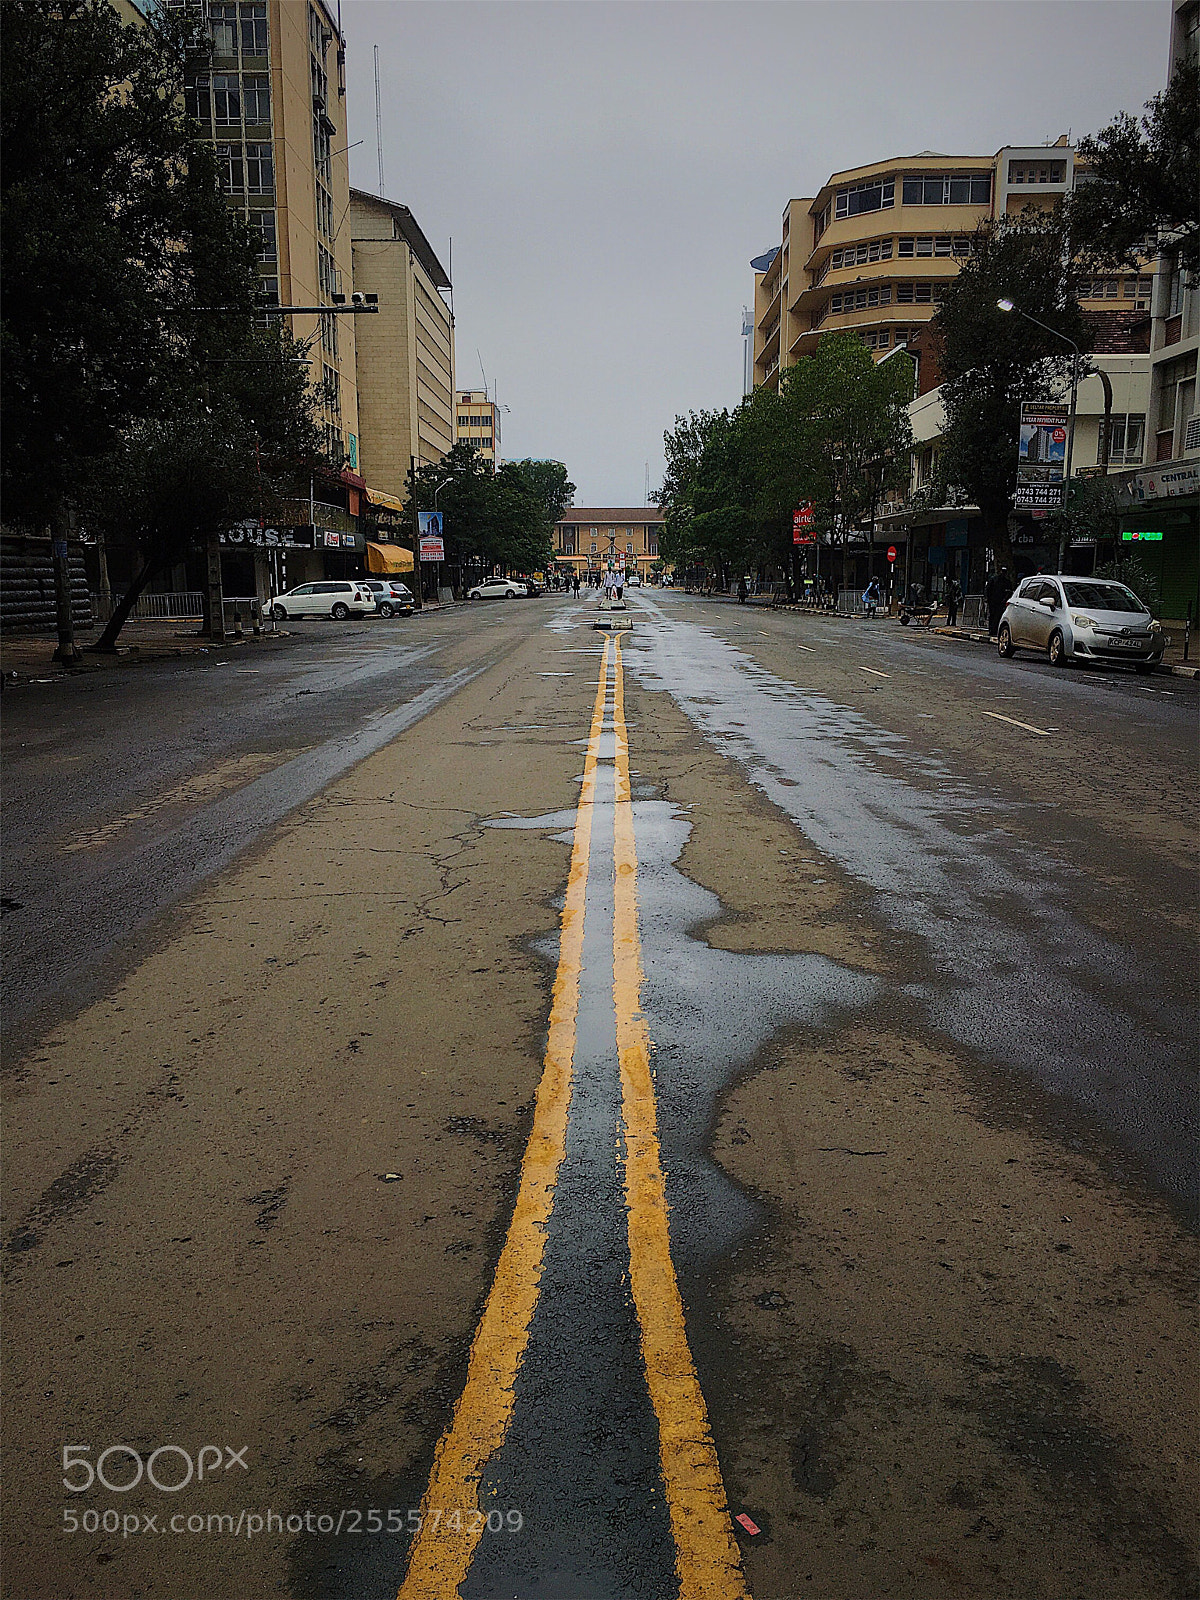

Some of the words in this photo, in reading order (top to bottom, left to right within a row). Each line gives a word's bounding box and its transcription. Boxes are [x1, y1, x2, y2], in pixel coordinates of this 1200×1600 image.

[1161, 470, 1198, 482] CENTRAL
[1017, 487, 1034, 495] 0743
[1035, 488, 1048, 496] 744
[1048, 488, 1061, 496] 271
[1048, 496, 1062, 504] 272
[793, 514, 815, 524] airtel
[1018, 533, 1034, 543] cba
